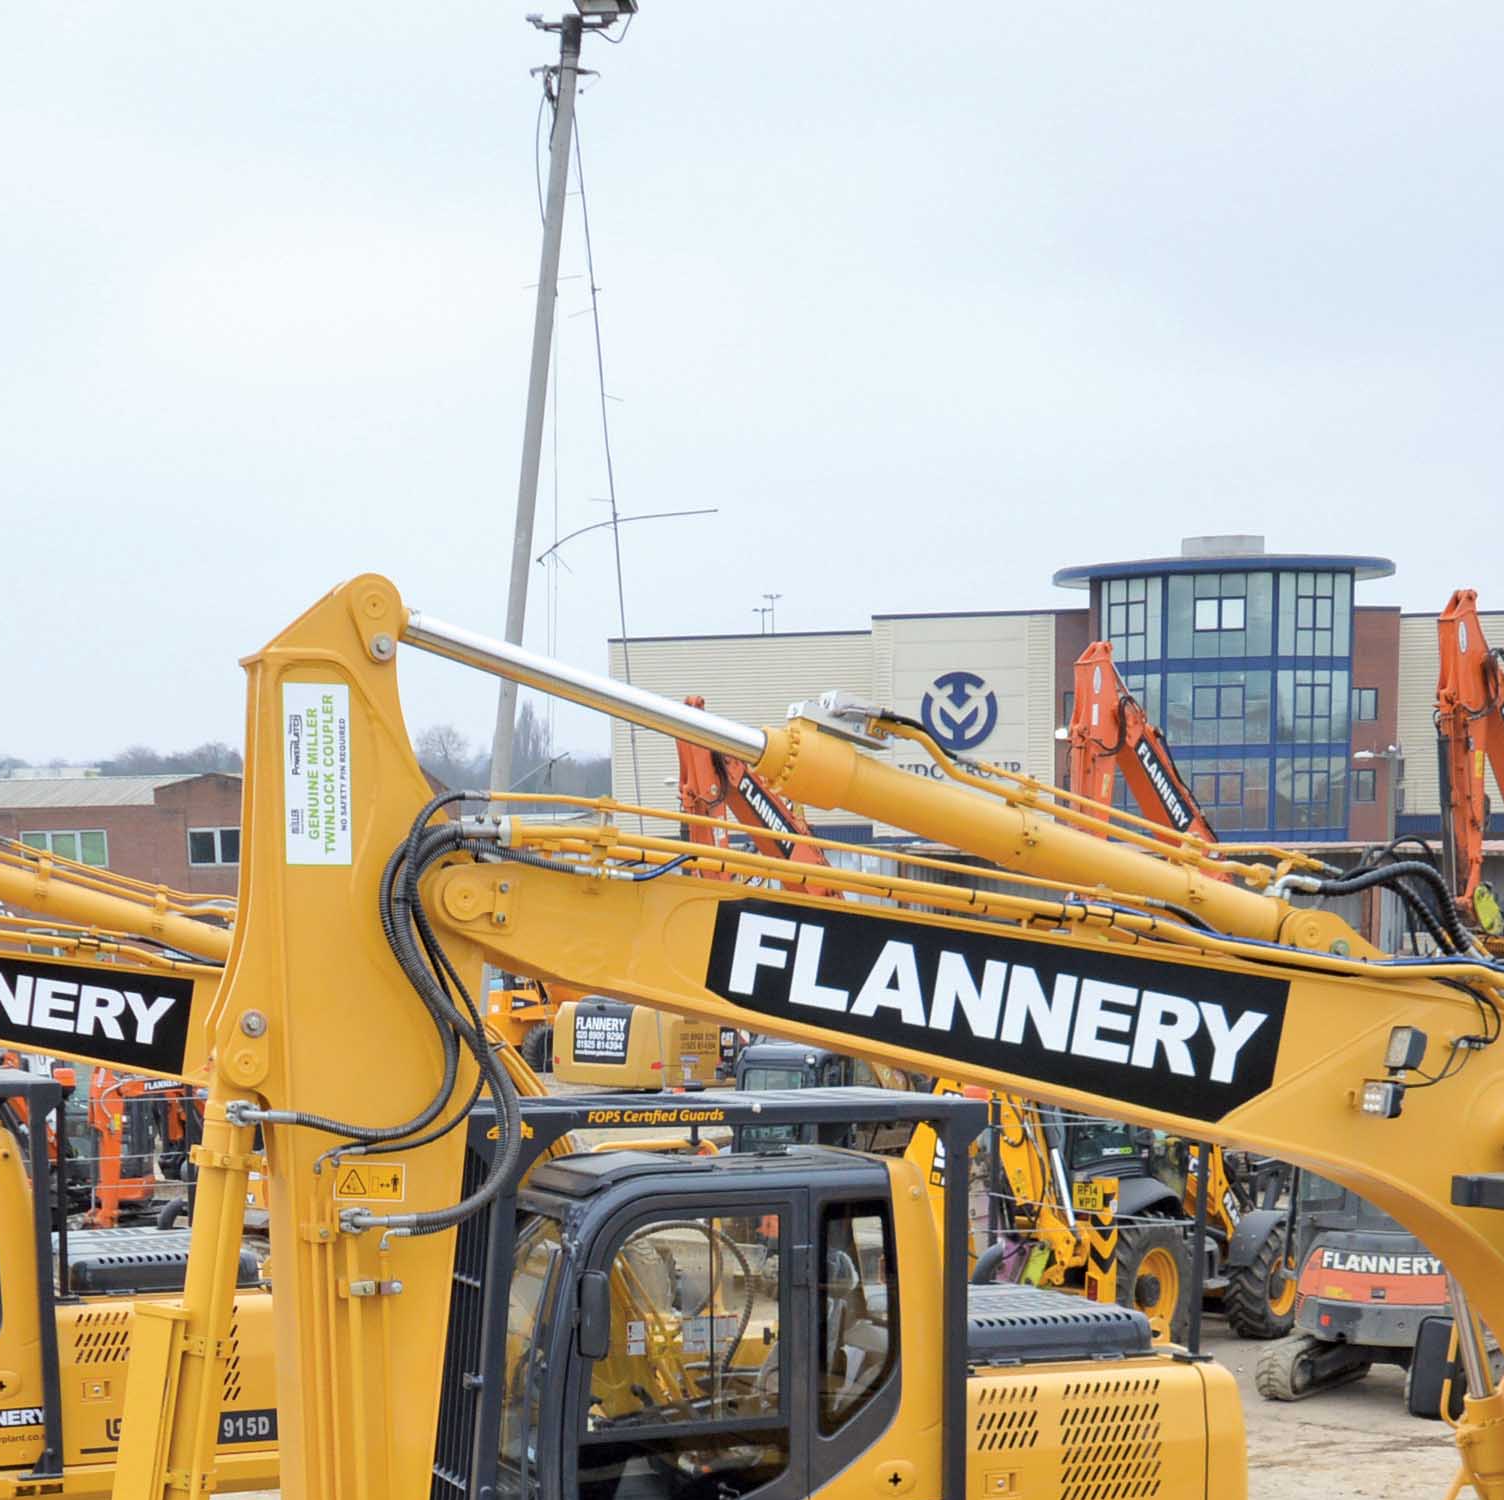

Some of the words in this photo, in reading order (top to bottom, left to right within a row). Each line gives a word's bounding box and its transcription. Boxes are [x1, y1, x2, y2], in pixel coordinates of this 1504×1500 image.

[306, 707, 318, 765] MILLER
[322, 694, 335, 768] COUPLER
[338, 717, 346, 763] REQUIRED
[307, 770, 320, 840] GENUINE
[1137, 741, 1189, 828] FLANNERY
[323, 773, 336, 856] TWINLOCK
[340, 818, 348, 832] NO
[576, 1016, 627, 1031] FLANNERY
[727, 911, 1269, 1084] FLANNERY
[588, 1110, 622, 1123] FOPS
[623, 1108, 678, 1125] Certified
[679, 1107, 725, 1122] Guards
[1321, 1250, 1442, 1275] FLANNERY
[223, 1415, 270, 1438] 915D
